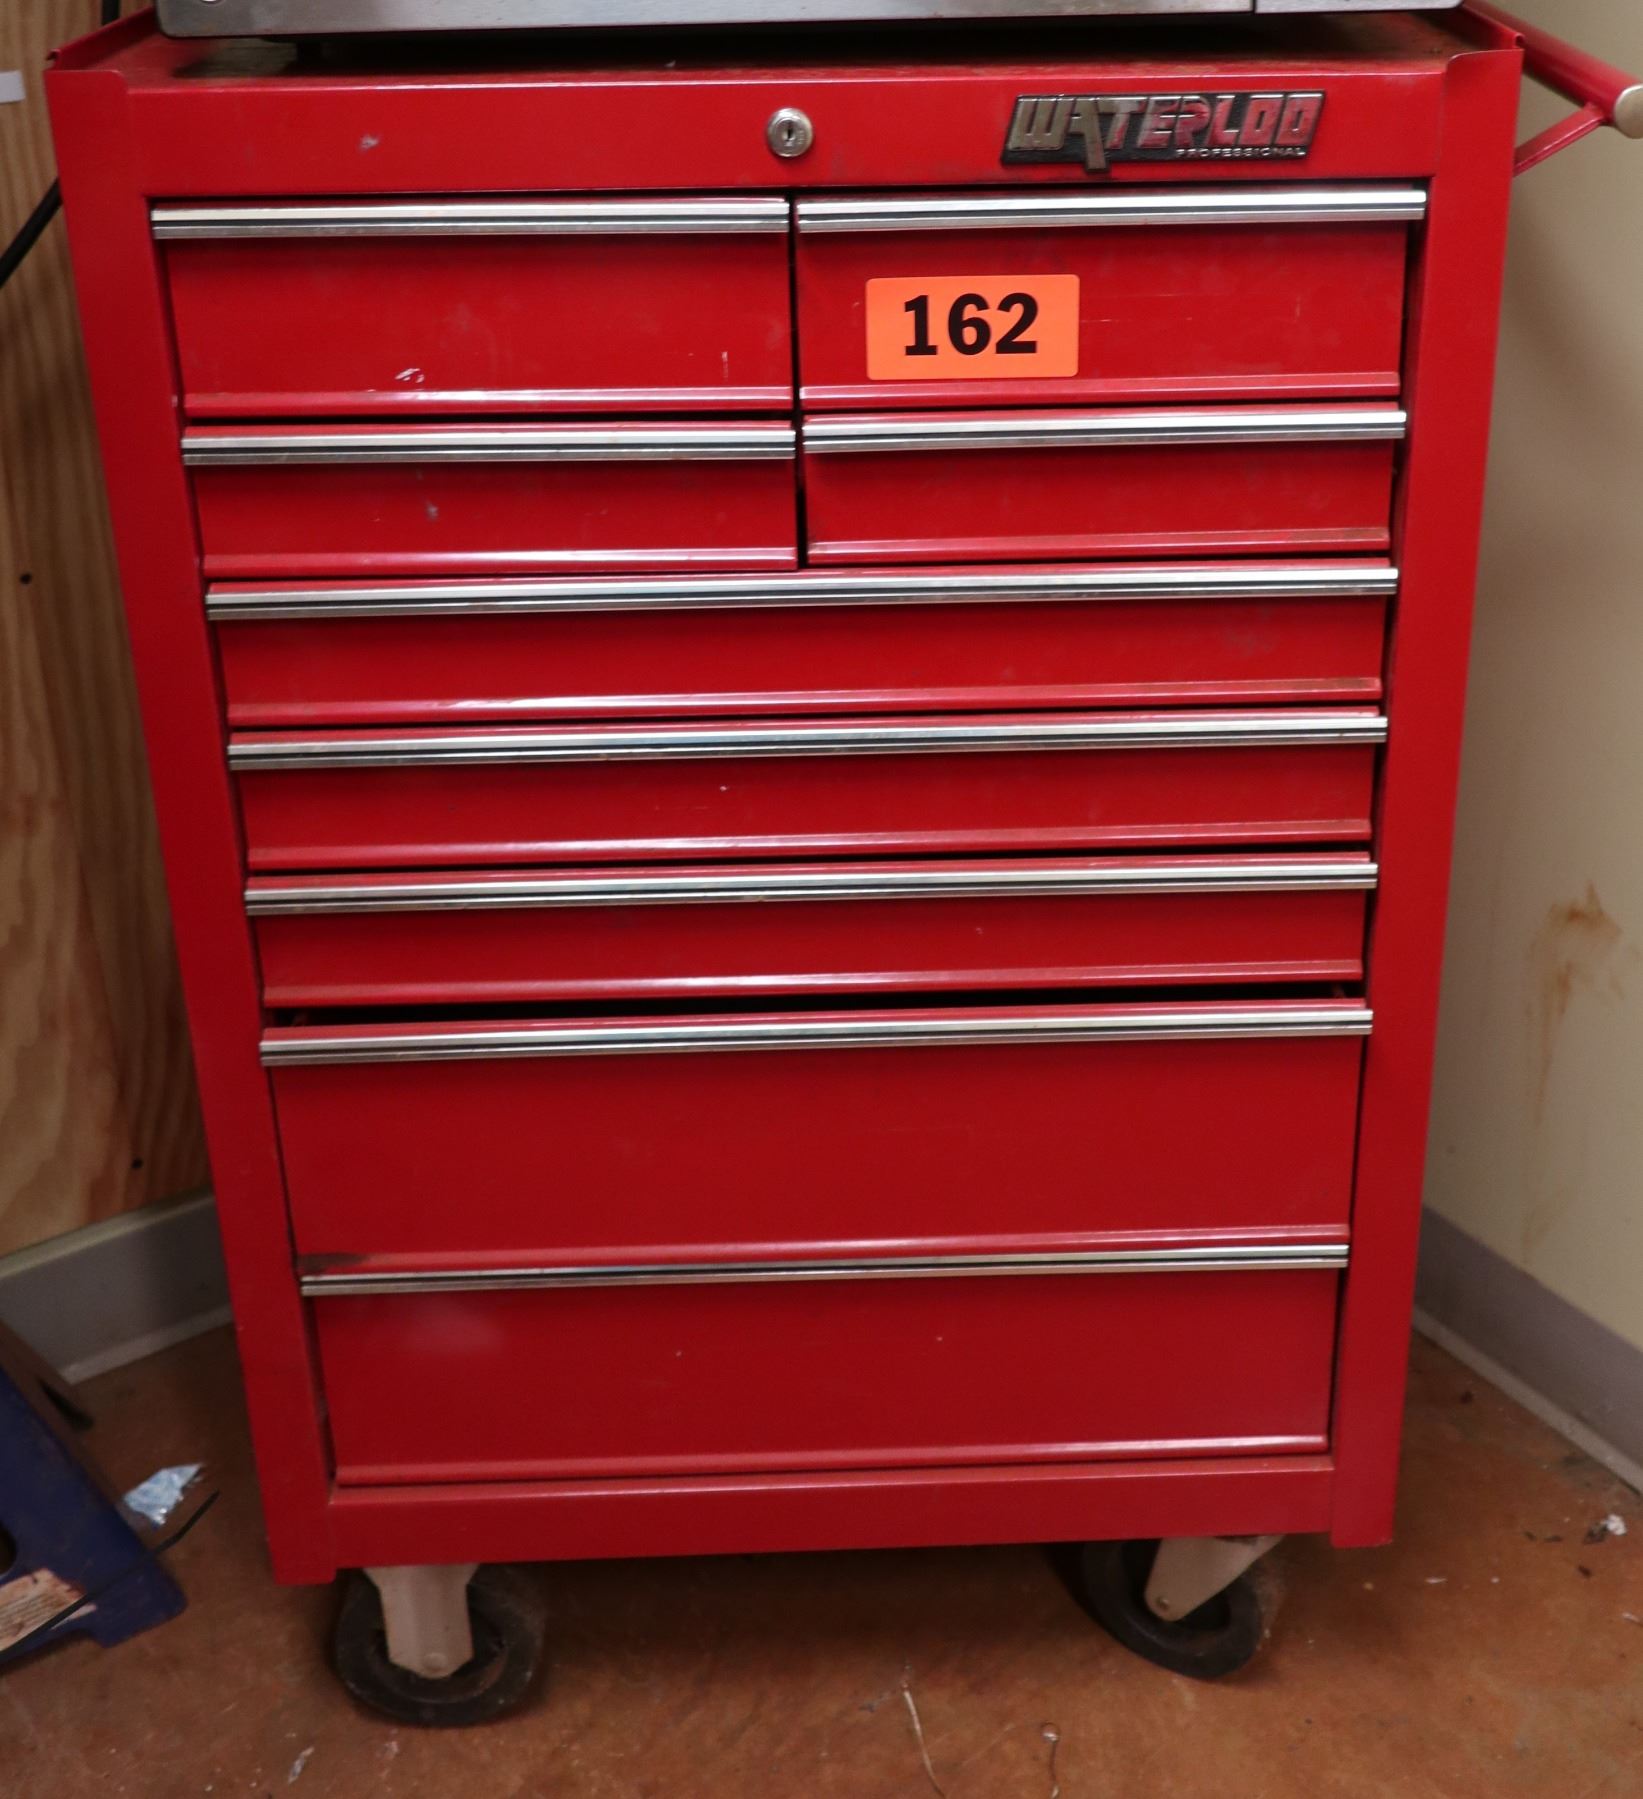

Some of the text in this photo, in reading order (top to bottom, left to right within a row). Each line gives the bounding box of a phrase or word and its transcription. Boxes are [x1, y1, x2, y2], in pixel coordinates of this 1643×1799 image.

[1006, 92, 1324, 170] WATERLOO
[1176, 147, 1306, 157] PROFESSIONAL
[904, 292, 1039, 356] 162
